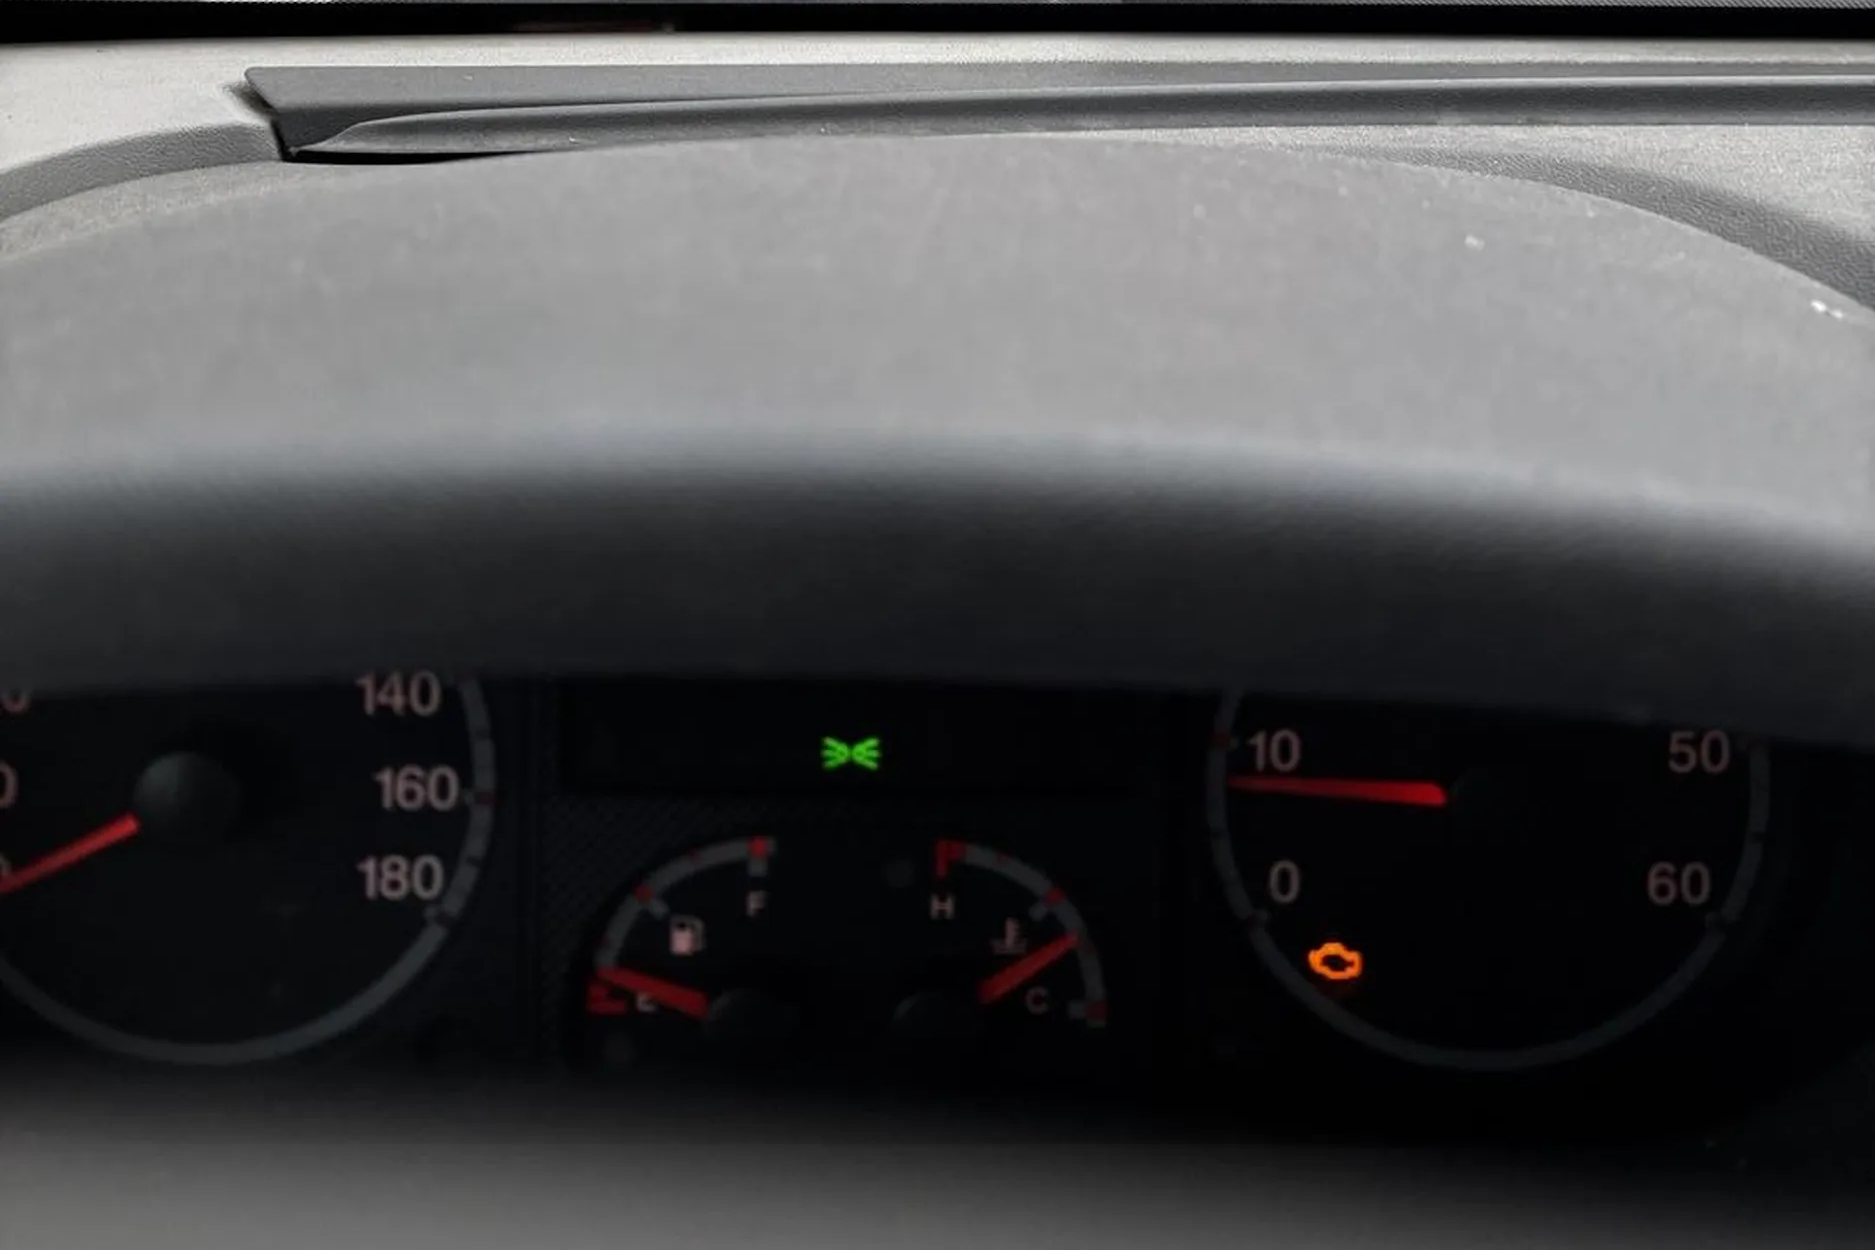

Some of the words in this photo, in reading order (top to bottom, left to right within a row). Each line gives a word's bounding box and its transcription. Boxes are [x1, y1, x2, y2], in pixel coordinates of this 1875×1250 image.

[355, 670, 441, 716] 140
[1246, 729, 1301, 772] 10
[1668, 730, 1730, 773] 50
[373, 764, 459, 812] 160
[356, 854, 444, 900] 180
[1269, 860, 1300, 903] 0
[1647, 861, 1710, 905] 60
[746, 890, 767, 917] F
[931, 894, 954, 920] H
[1025, 986, 1049, 1015] C
